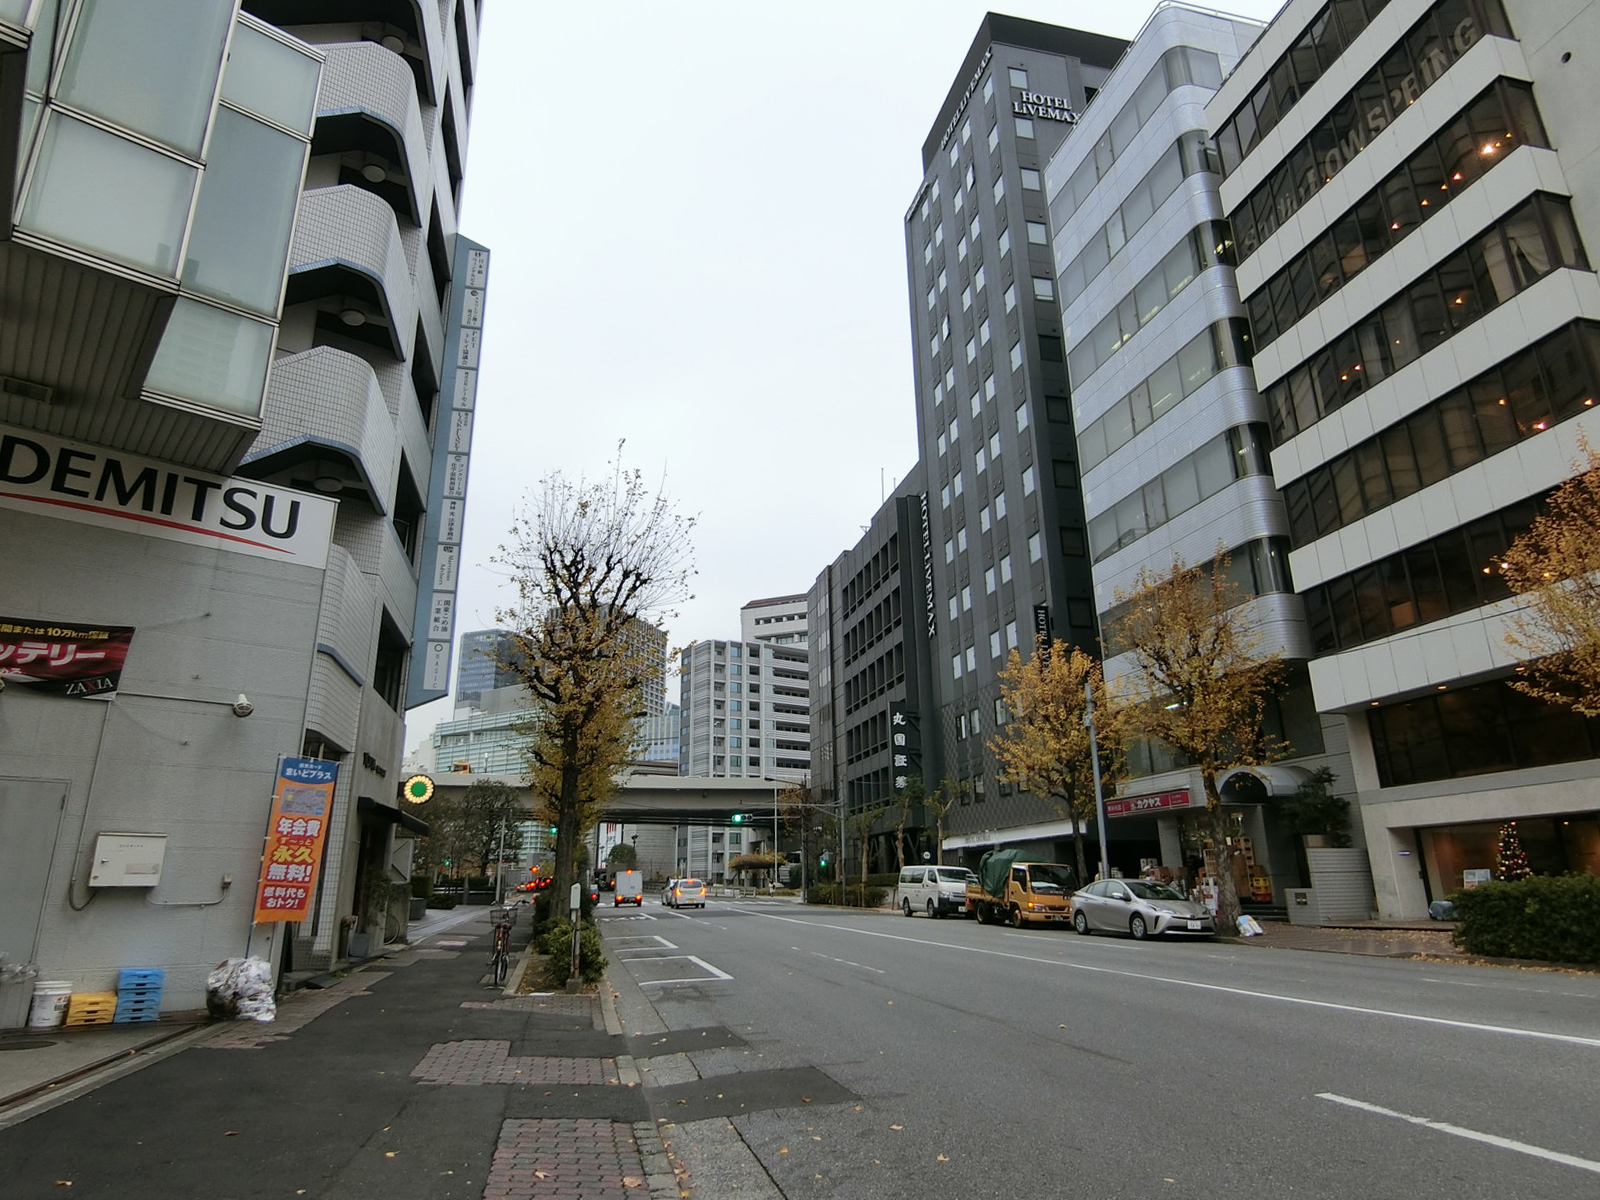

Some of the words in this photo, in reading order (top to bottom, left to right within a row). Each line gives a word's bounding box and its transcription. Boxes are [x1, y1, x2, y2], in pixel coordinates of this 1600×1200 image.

[1021, 91, 1072, 110] HOTEL
[1, 434, 301, 539] DEMITSU
[920, 492, 930, 552] HOTEL
[0, 623, 110, 640] 間または10万km保証
[277, 817, 321, 837] 年会費
[271, 846, 314, 864] 永久
[263, 885, 306, 899] 燃料代も
